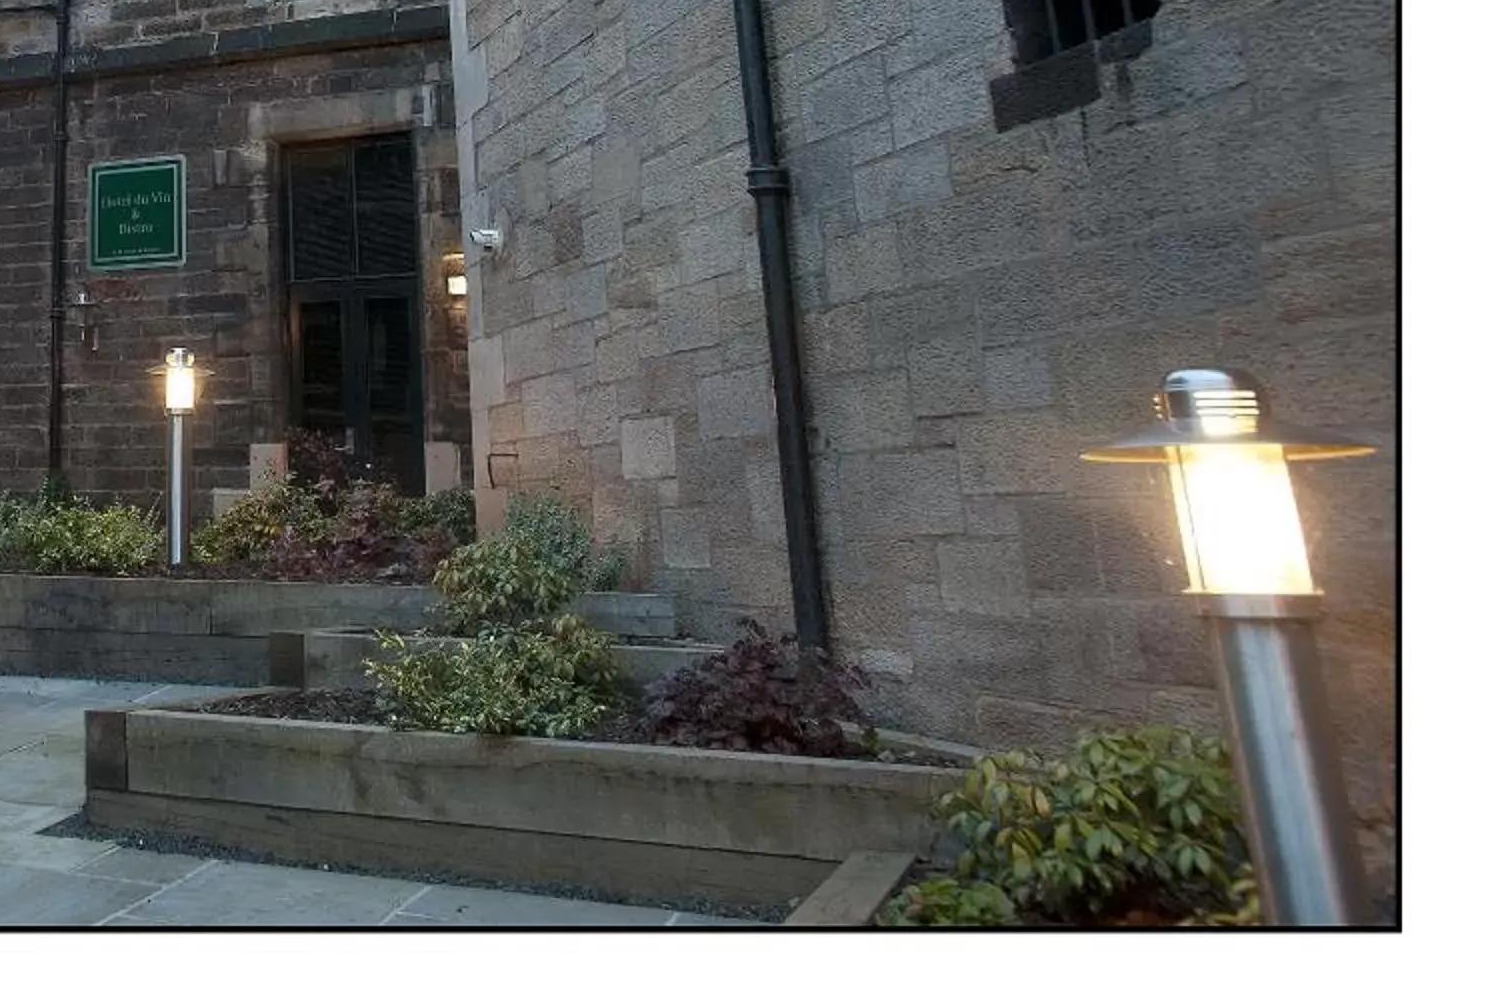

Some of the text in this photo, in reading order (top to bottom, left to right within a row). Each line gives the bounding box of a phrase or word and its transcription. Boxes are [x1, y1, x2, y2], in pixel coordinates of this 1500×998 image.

[100, 190, 172, 209] Hotel du Vin
[131, 209, 140, 220] &
